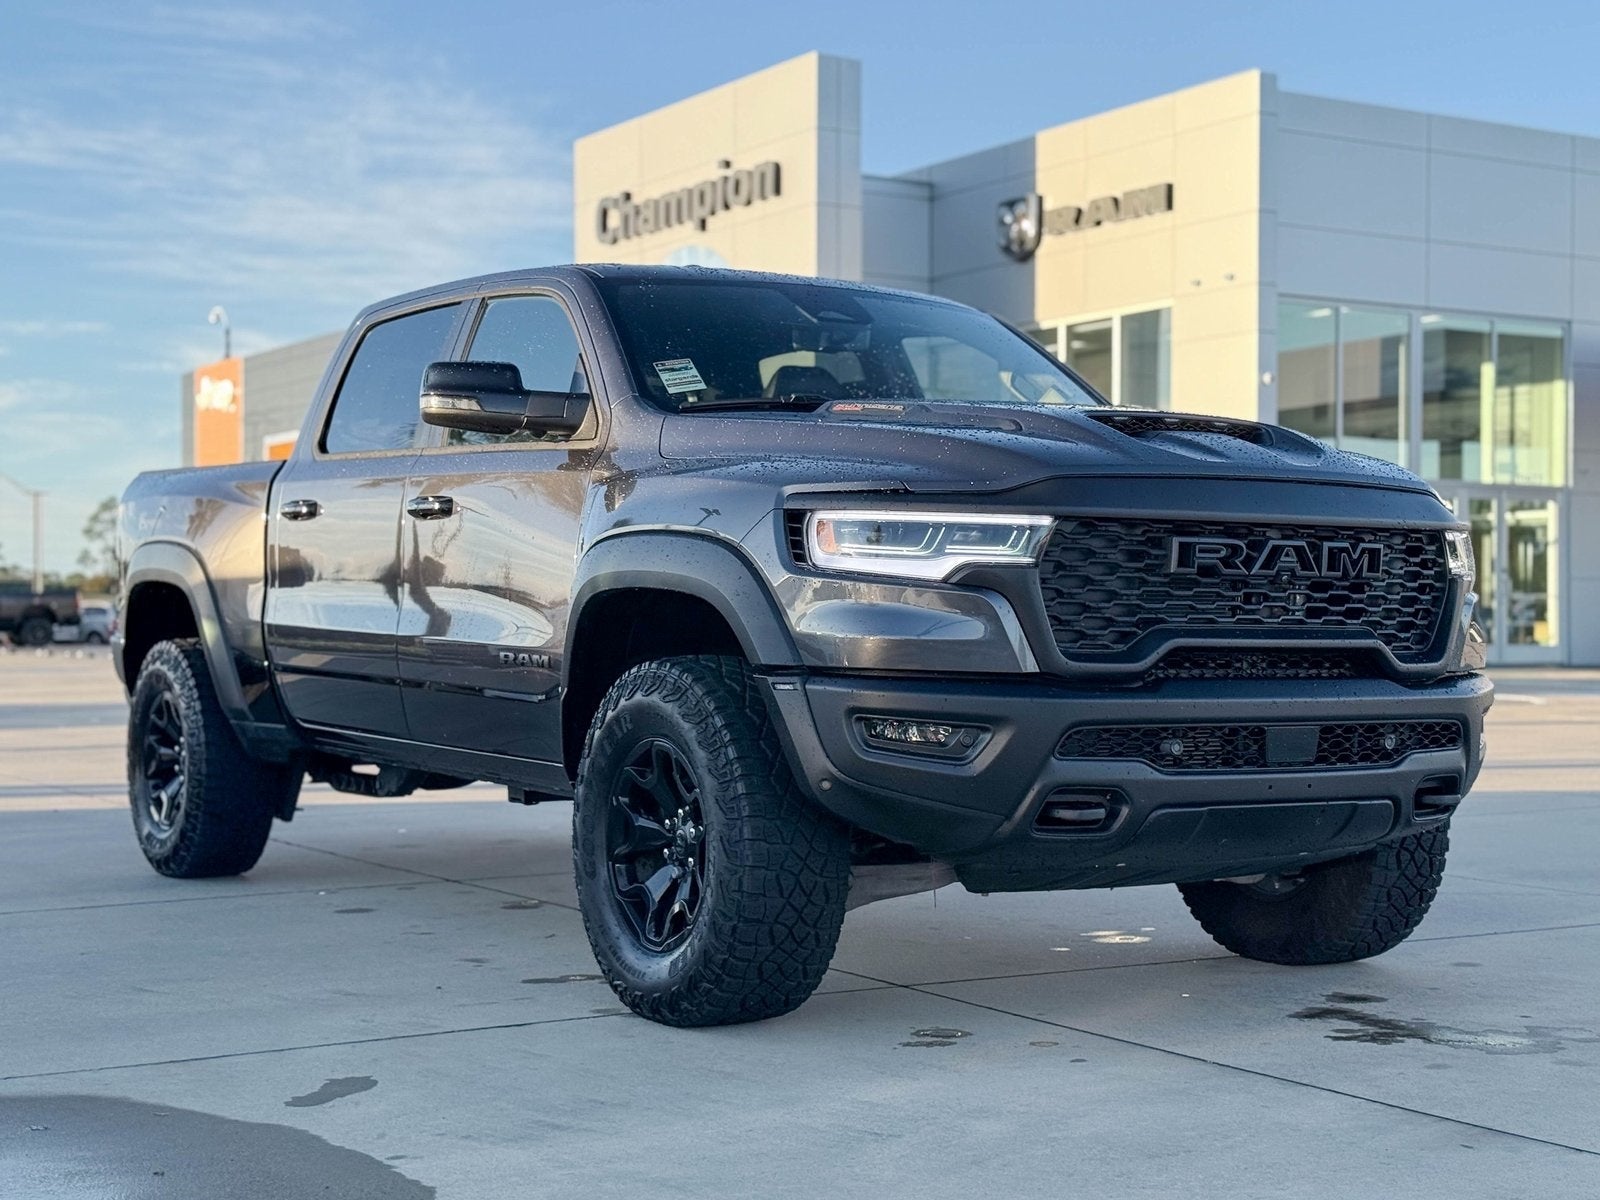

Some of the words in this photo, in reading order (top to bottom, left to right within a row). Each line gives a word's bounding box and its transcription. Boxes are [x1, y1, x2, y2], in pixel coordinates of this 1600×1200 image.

[596, 159, 782, 245] Champion
[1043, 183, 1173, 236] RAM
[1171, 537, 1384, 577] RAM
[499, 651, 551, 669] RAM
[582, 711, 634, 881] GOODEAR
